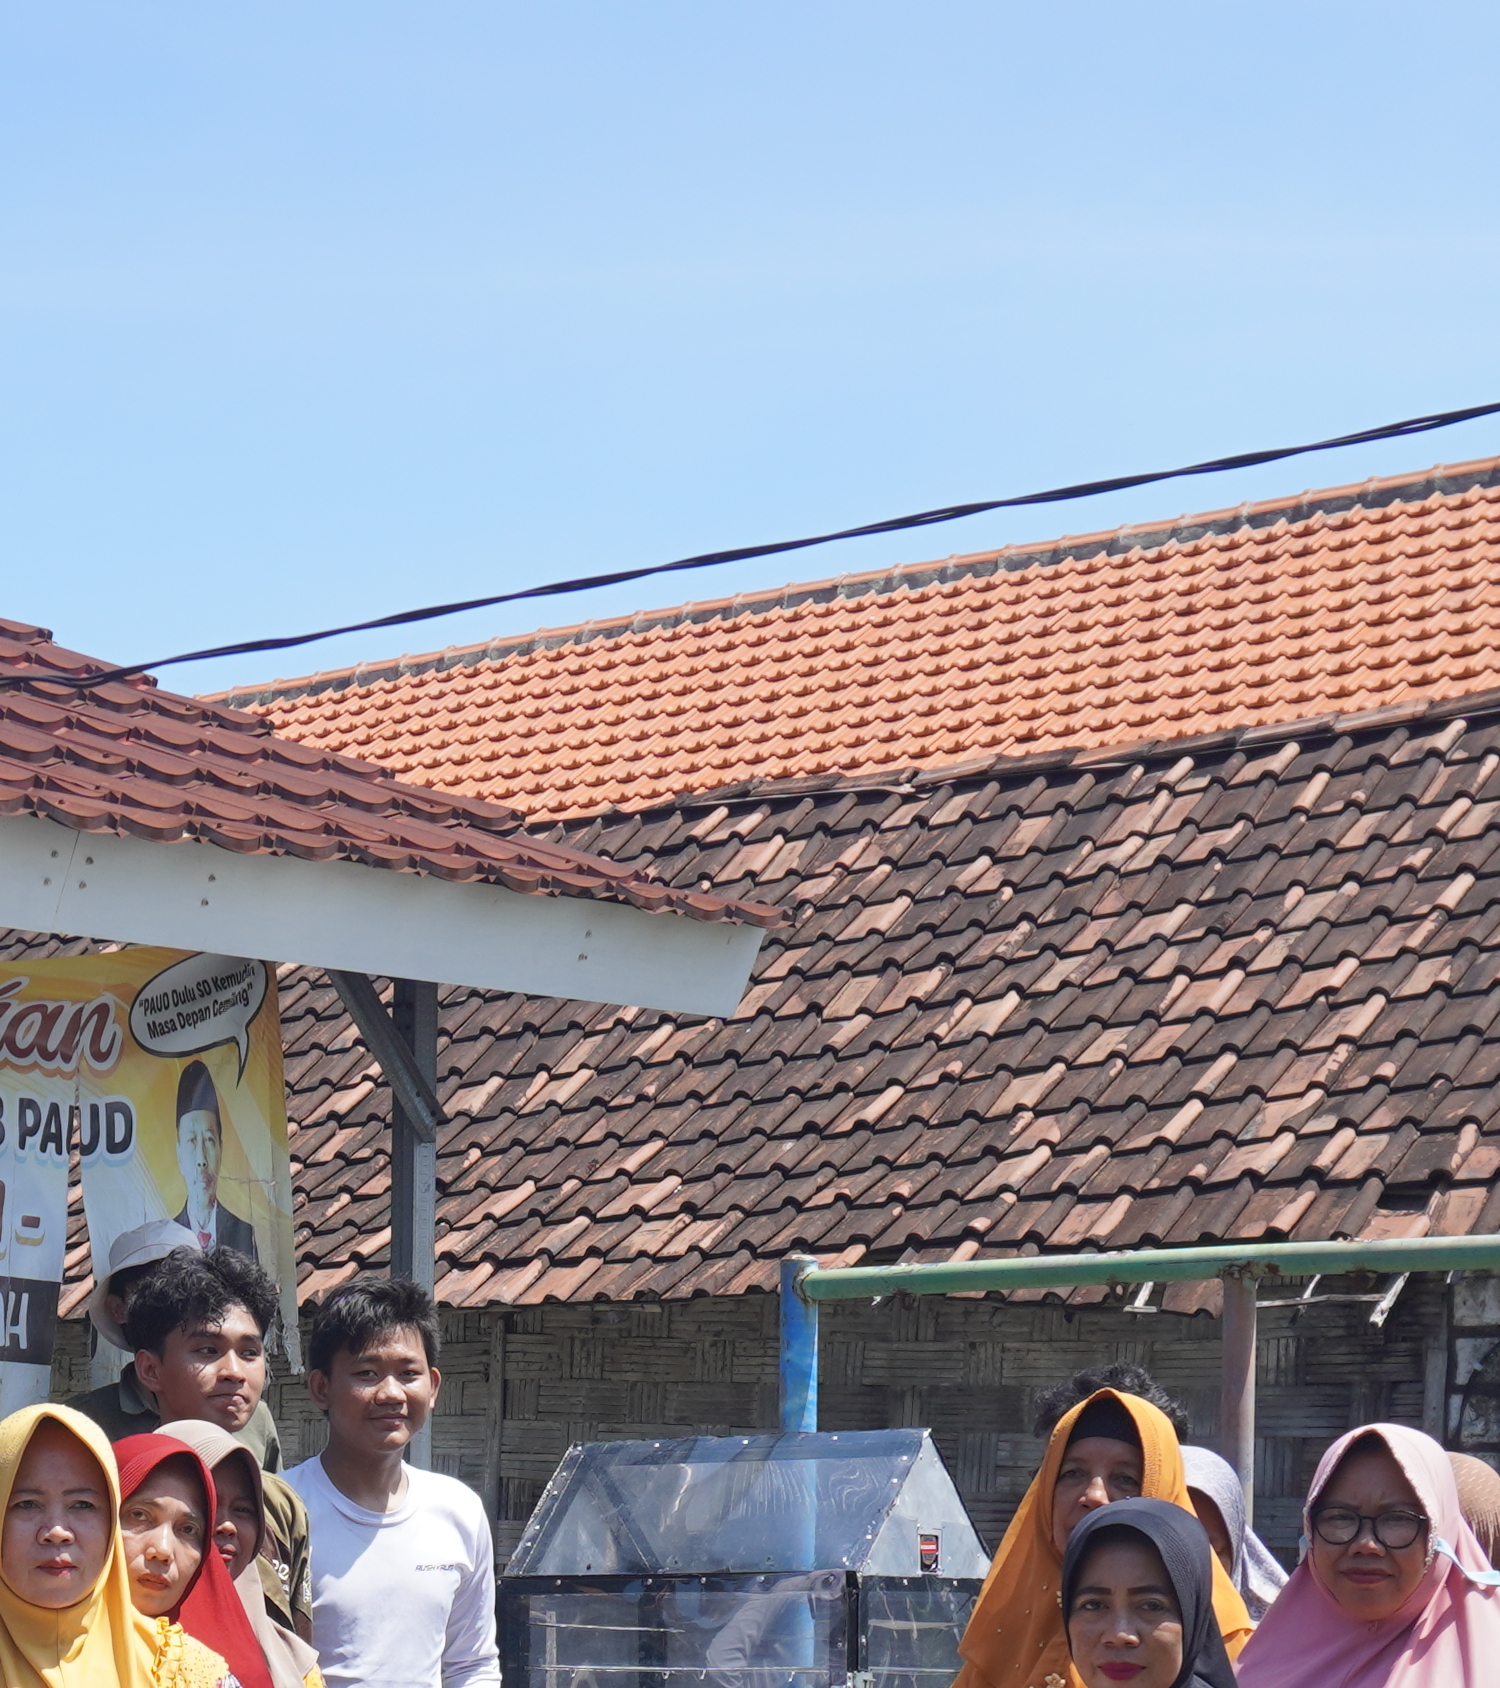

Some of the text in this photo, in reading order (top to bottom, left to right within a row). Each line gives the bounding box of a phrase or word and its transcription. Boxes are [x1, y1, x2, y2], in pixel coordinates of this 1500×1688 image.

[171, 985, 197, 1008] Dulu
[195, 979, 212, 999] SD
[146, 1019, 178, 1040] Masa
[176, 1005, 211, 1029] Depan
[18, 1097, 134, 1157] PAUD
